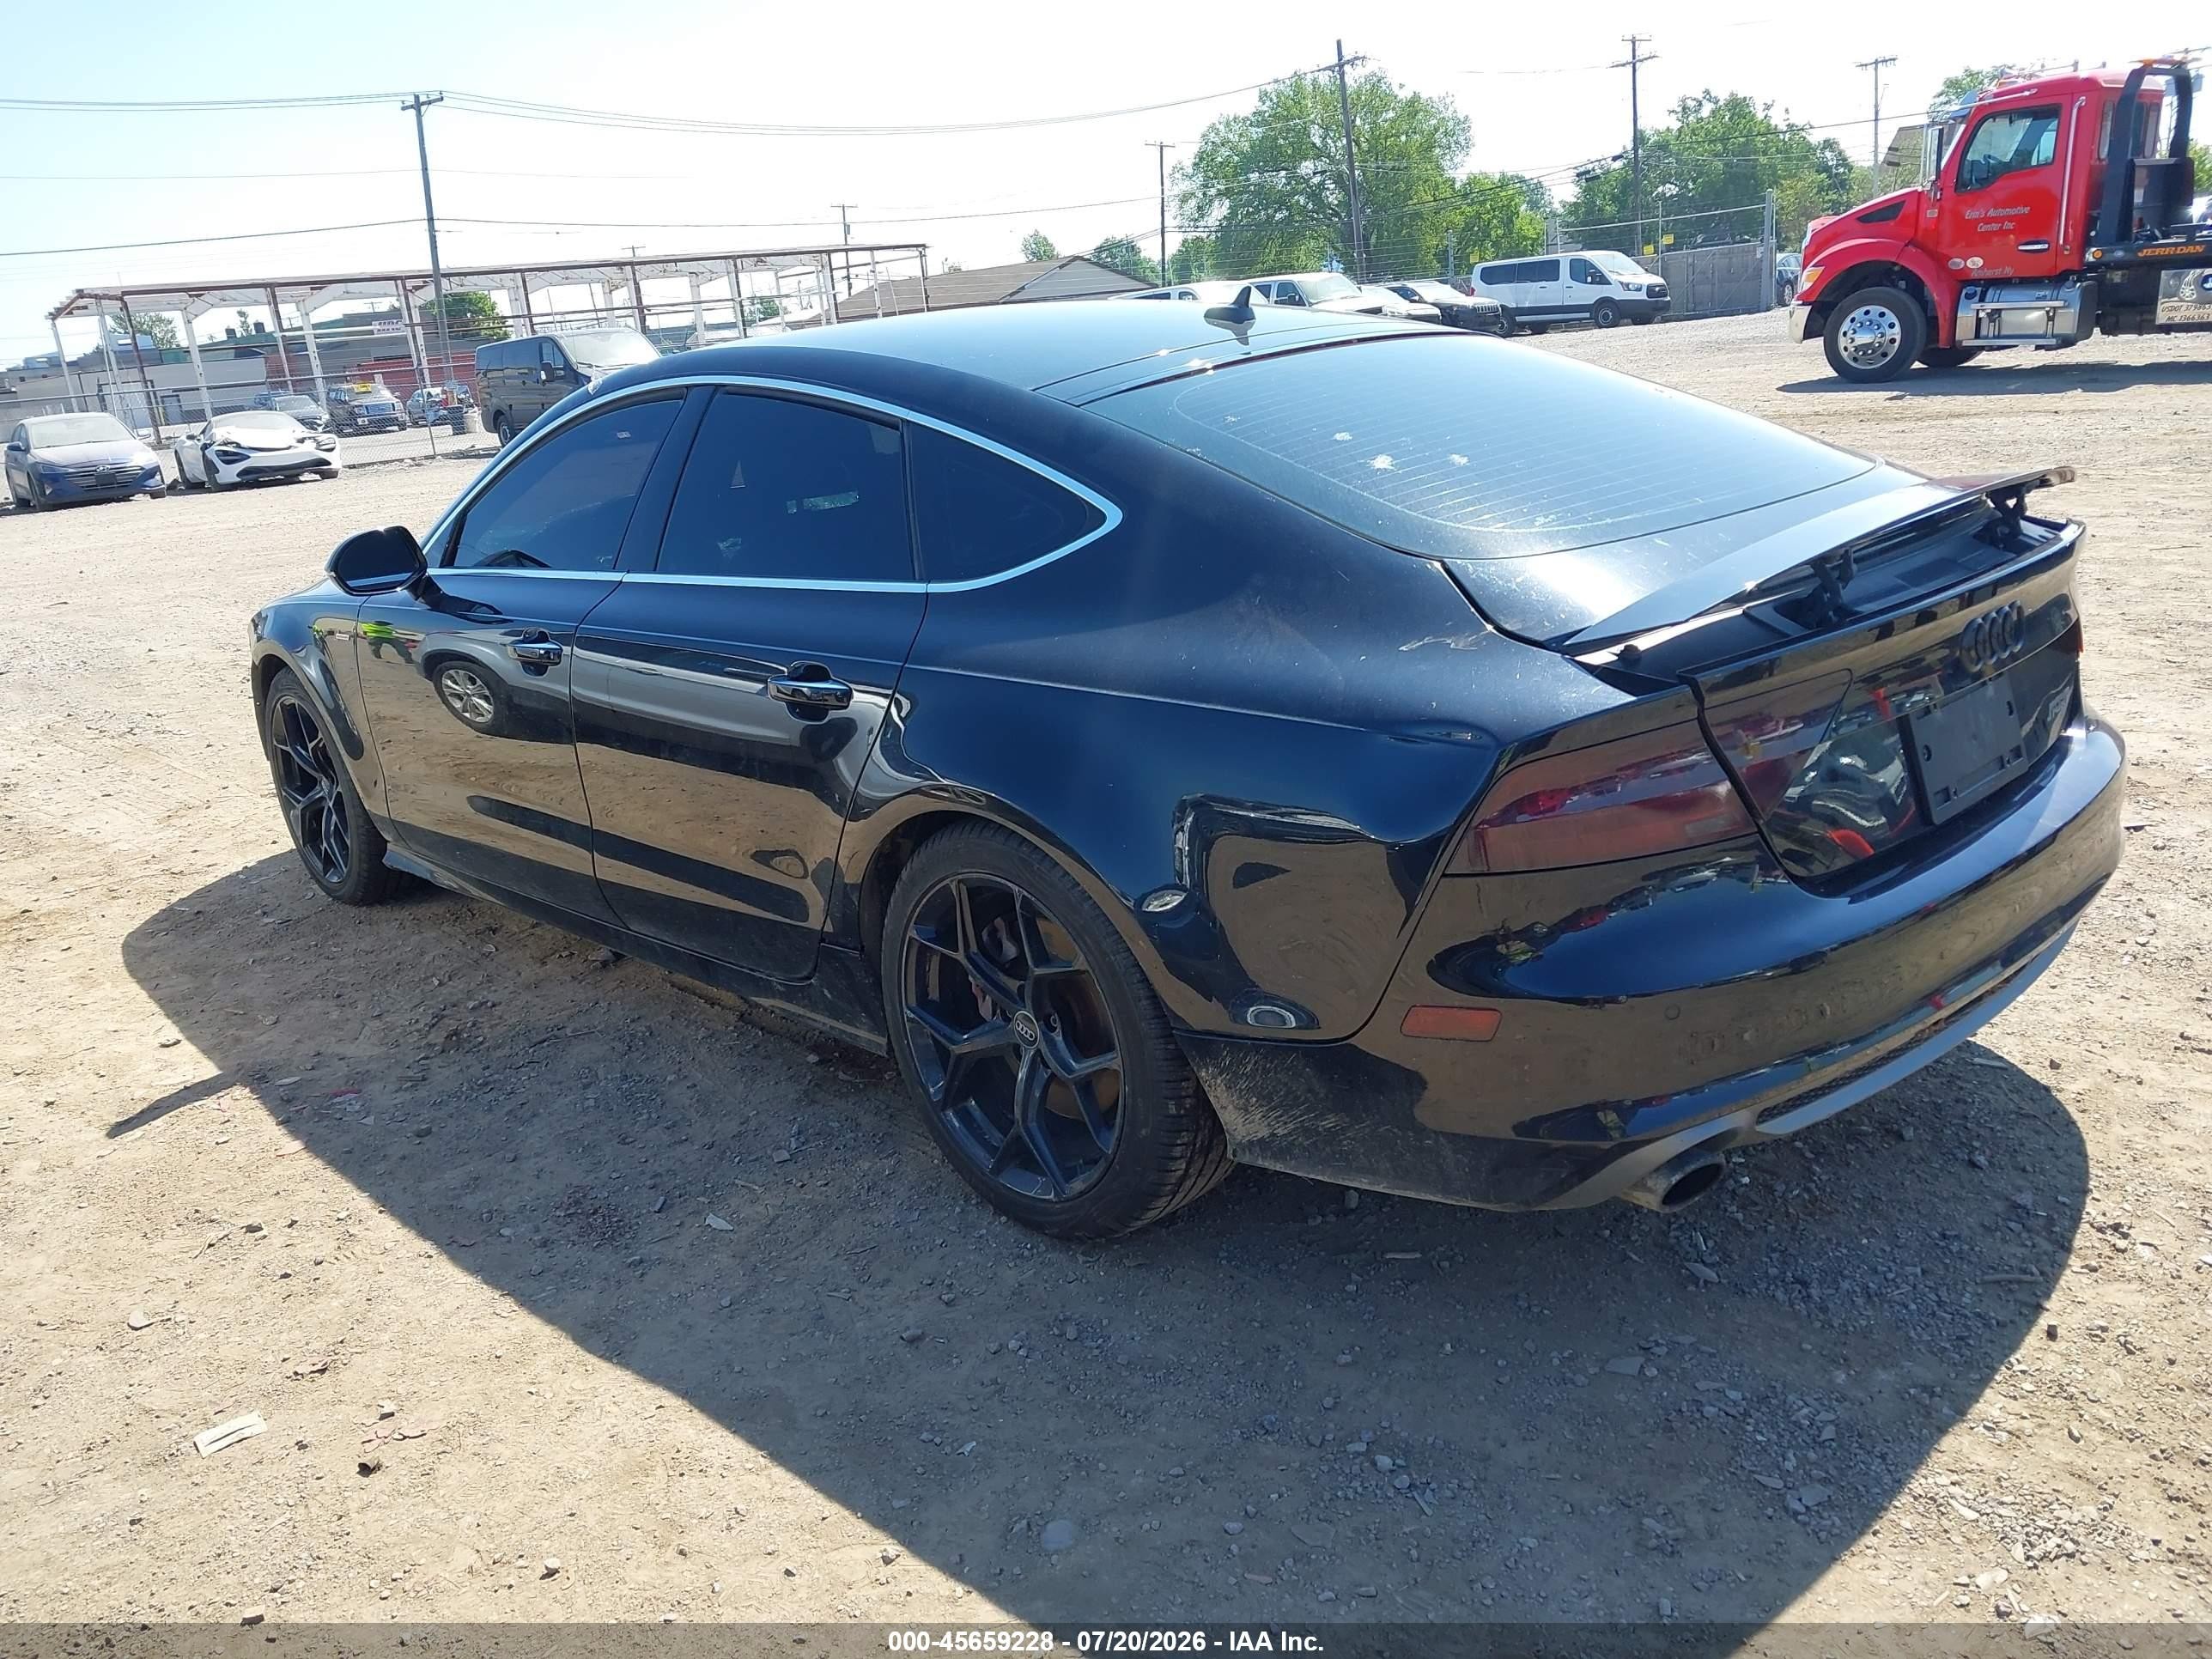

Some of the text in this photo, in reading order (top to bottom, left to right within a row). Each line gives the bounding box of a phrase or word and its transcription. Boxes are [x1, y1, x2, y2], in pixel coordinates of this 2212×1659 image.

[1987, 206, 2031, 217] Automotive
[1977, 220, 2015, 232] Center Inc
